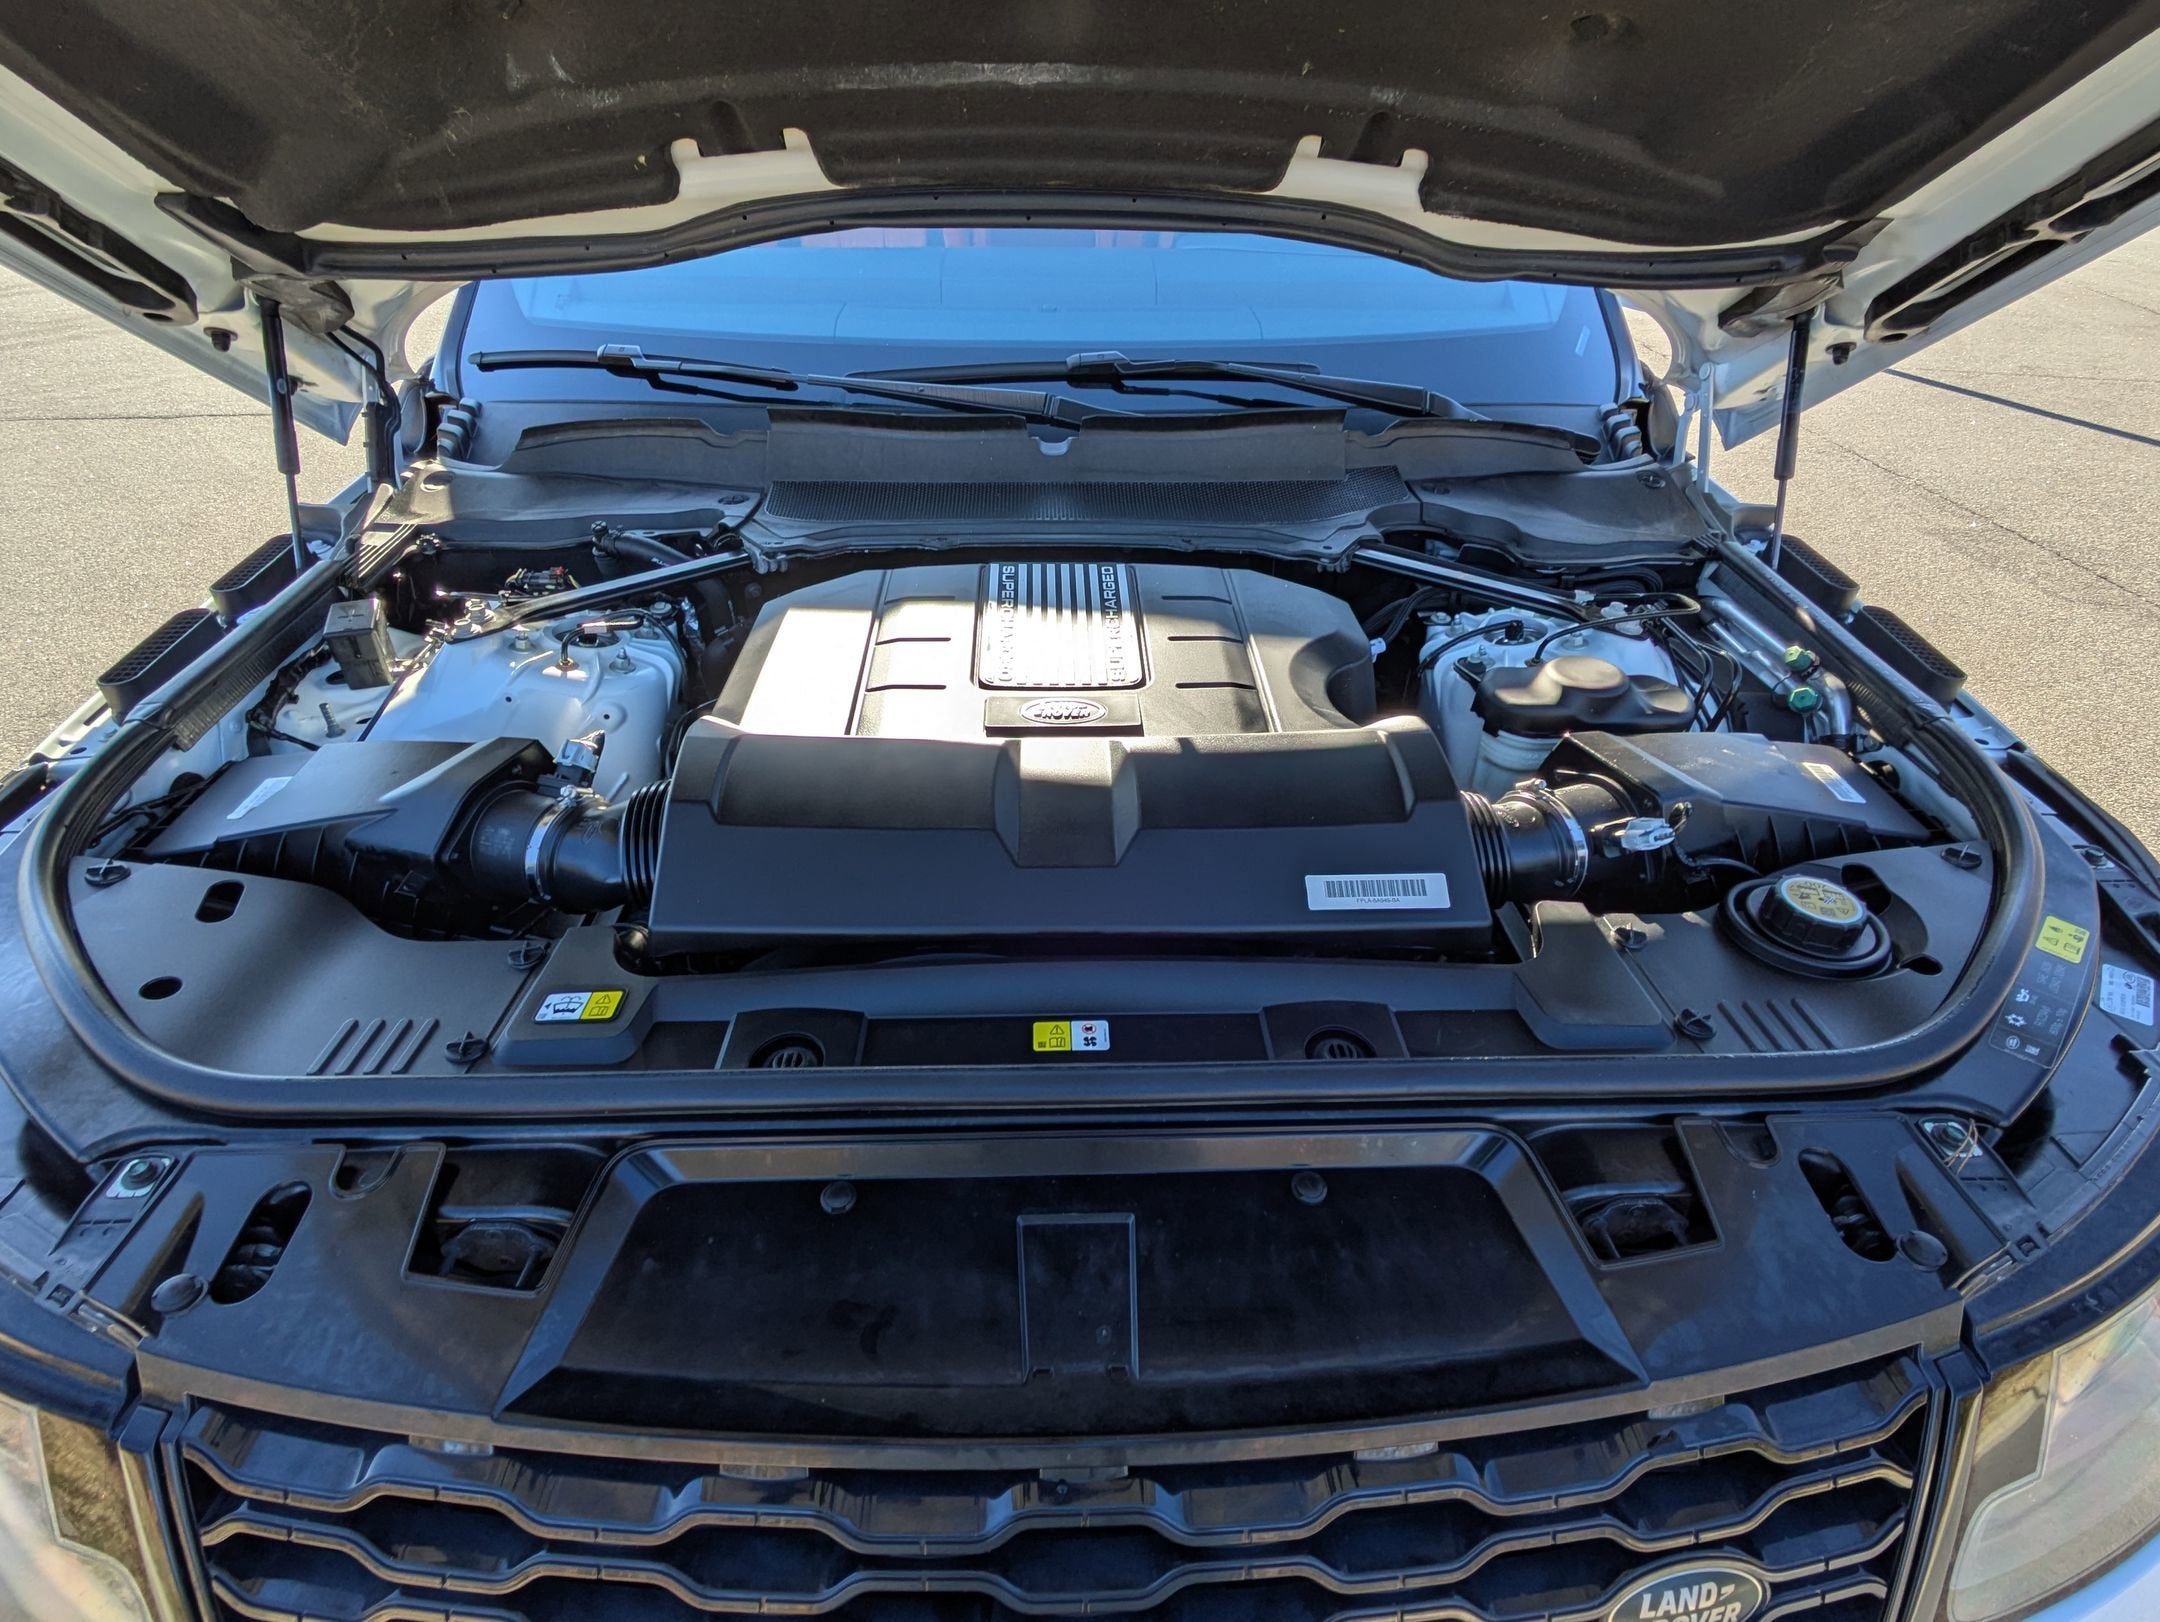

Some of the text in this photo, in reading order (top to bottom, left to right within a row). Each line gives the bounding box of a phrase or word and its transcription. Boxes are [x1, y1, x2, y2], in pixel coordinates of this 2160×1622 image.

[999, 565, 1015, 682] SUPERCHARD
[1102, 565, 1125, 682] SUPRCHARGED
[1640, 1581, 1718, 1619] LAND
[1650, 1602, 1742, 1622] VER
